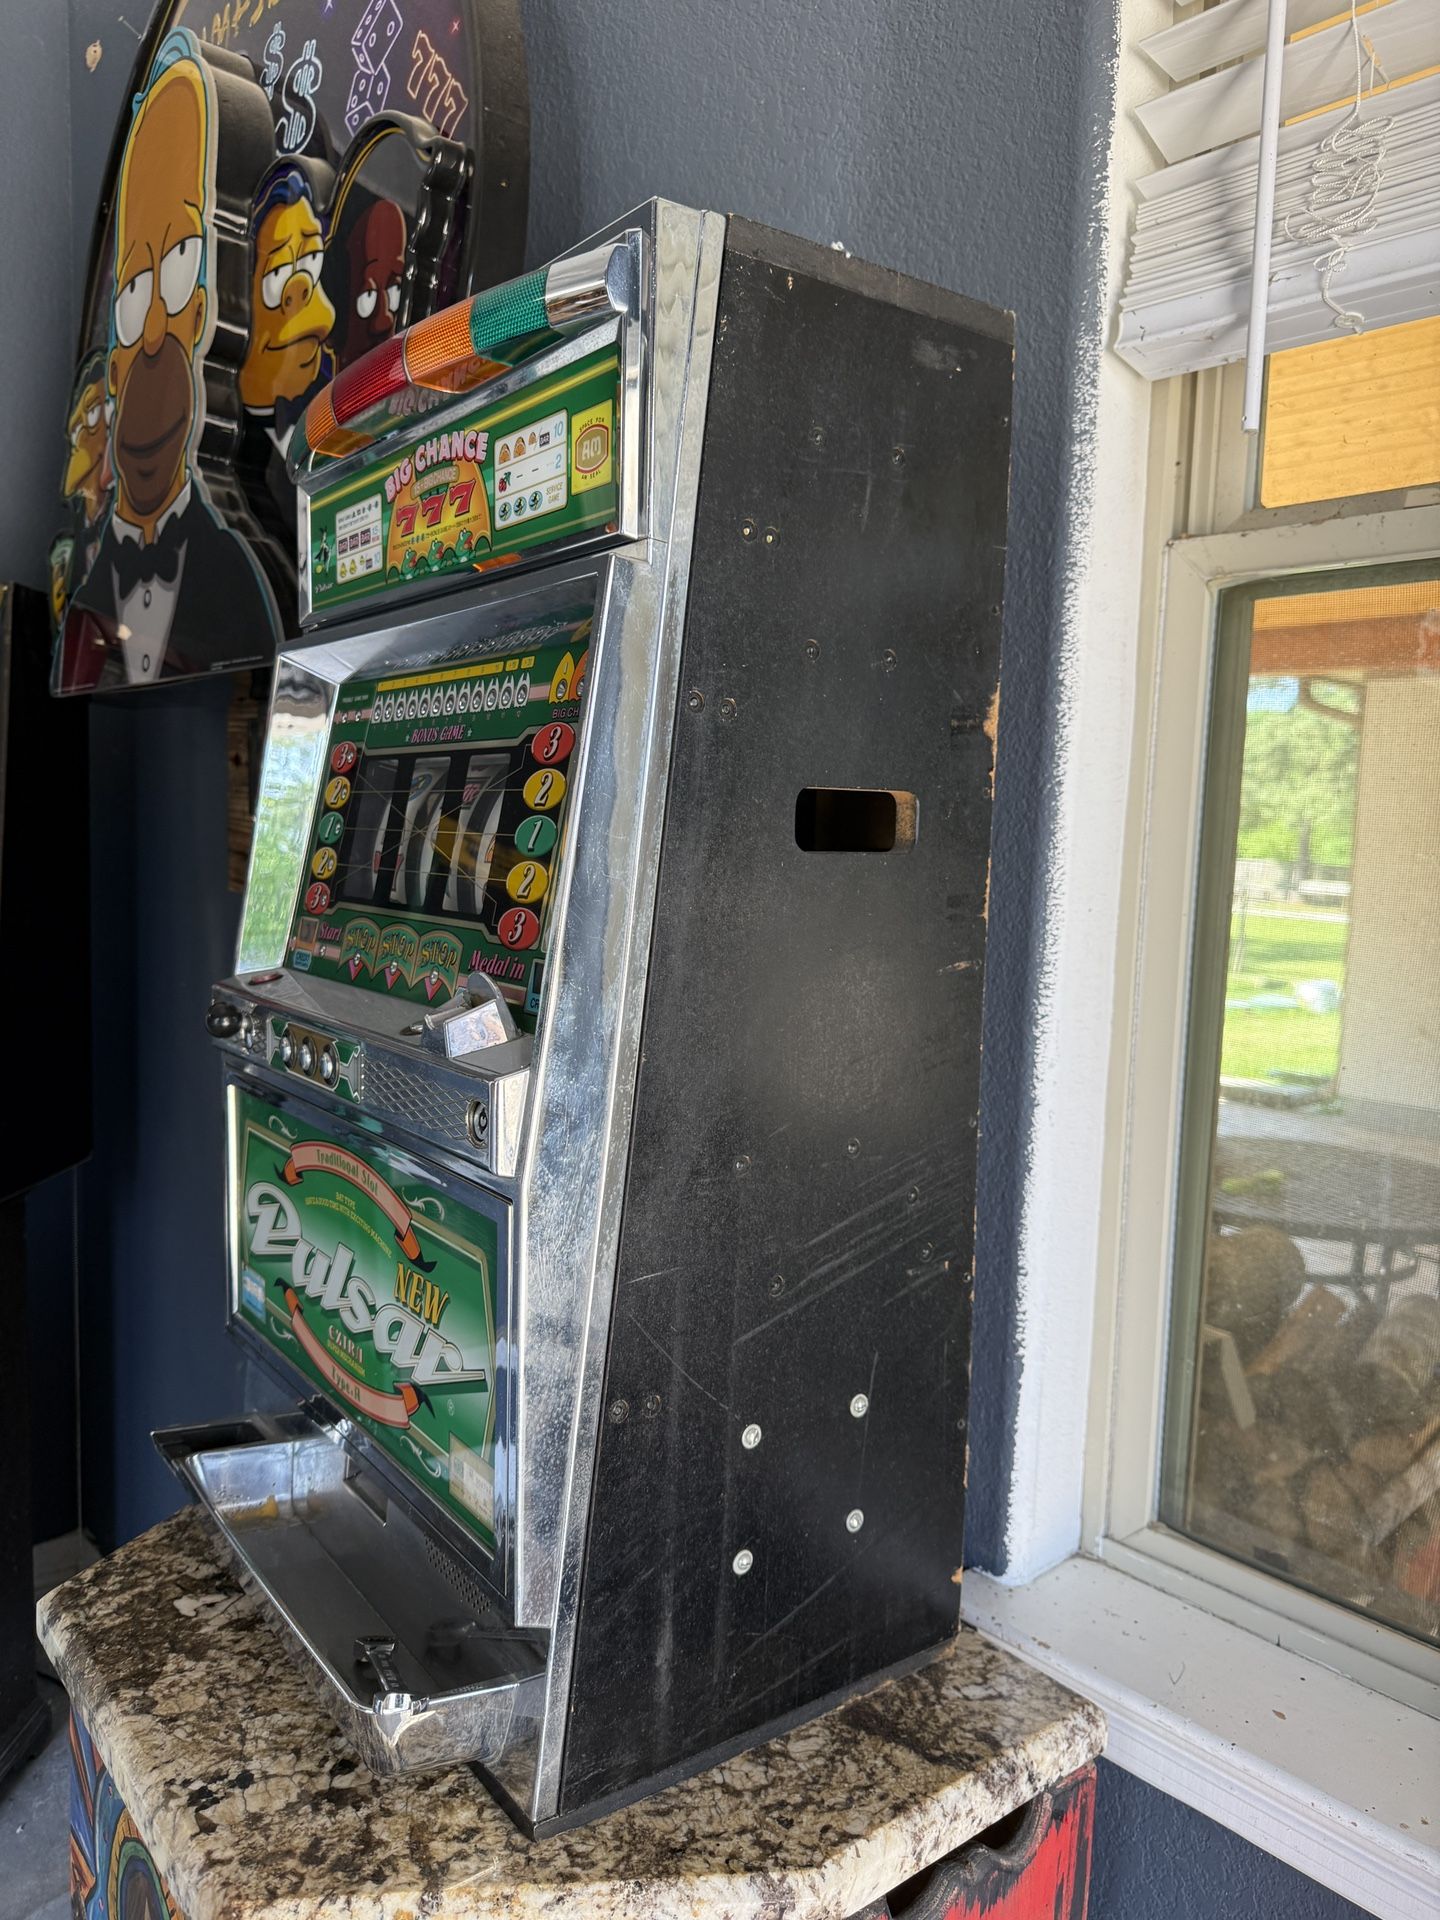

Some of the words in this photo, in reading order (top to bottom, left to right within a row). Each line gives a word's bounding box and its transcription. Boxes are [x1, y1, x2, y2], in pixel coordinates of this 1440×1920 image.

[554, 421, 564, 437] 10
[555, 453, 562, 470] 2
[581, 436, 602, 462] AM
[384, 458, 413, 503] BIG
[415, 430, 489, 473] CHANCE
[552, 707, 567, 719] BIG
[411, 726, 438, 743] BONUS
[439, 724, 466, 740] GAME
[543, 725, 562, 760] 3
[338, 744, 348, 769] 3
[331, 778, 342, 805] 2
[534, 771, 552, 807] 2
[324, 815, 332, 840] 1
[527, 819, 543, 852] 1
[318, 850, 328, 875] 2
[516, 864, 534, 900] 2
[311, 885, 322, 910] 3
[319, 922, 342, 942] Start
[508, 911, 528, 947] 3
[381, 933, 415, 962] STOP
[420, 938, 458, 971] STOP
[468, 949, 509, 977] Medal
[510, 959, 525, 981] in
[316, 1149, 359, 1180] Traditional
[362, 1169, 379, 1196] Slot
[246, 1180, 488, 1389] Pulsar
[394, 1262, 449, 1326] NEW
